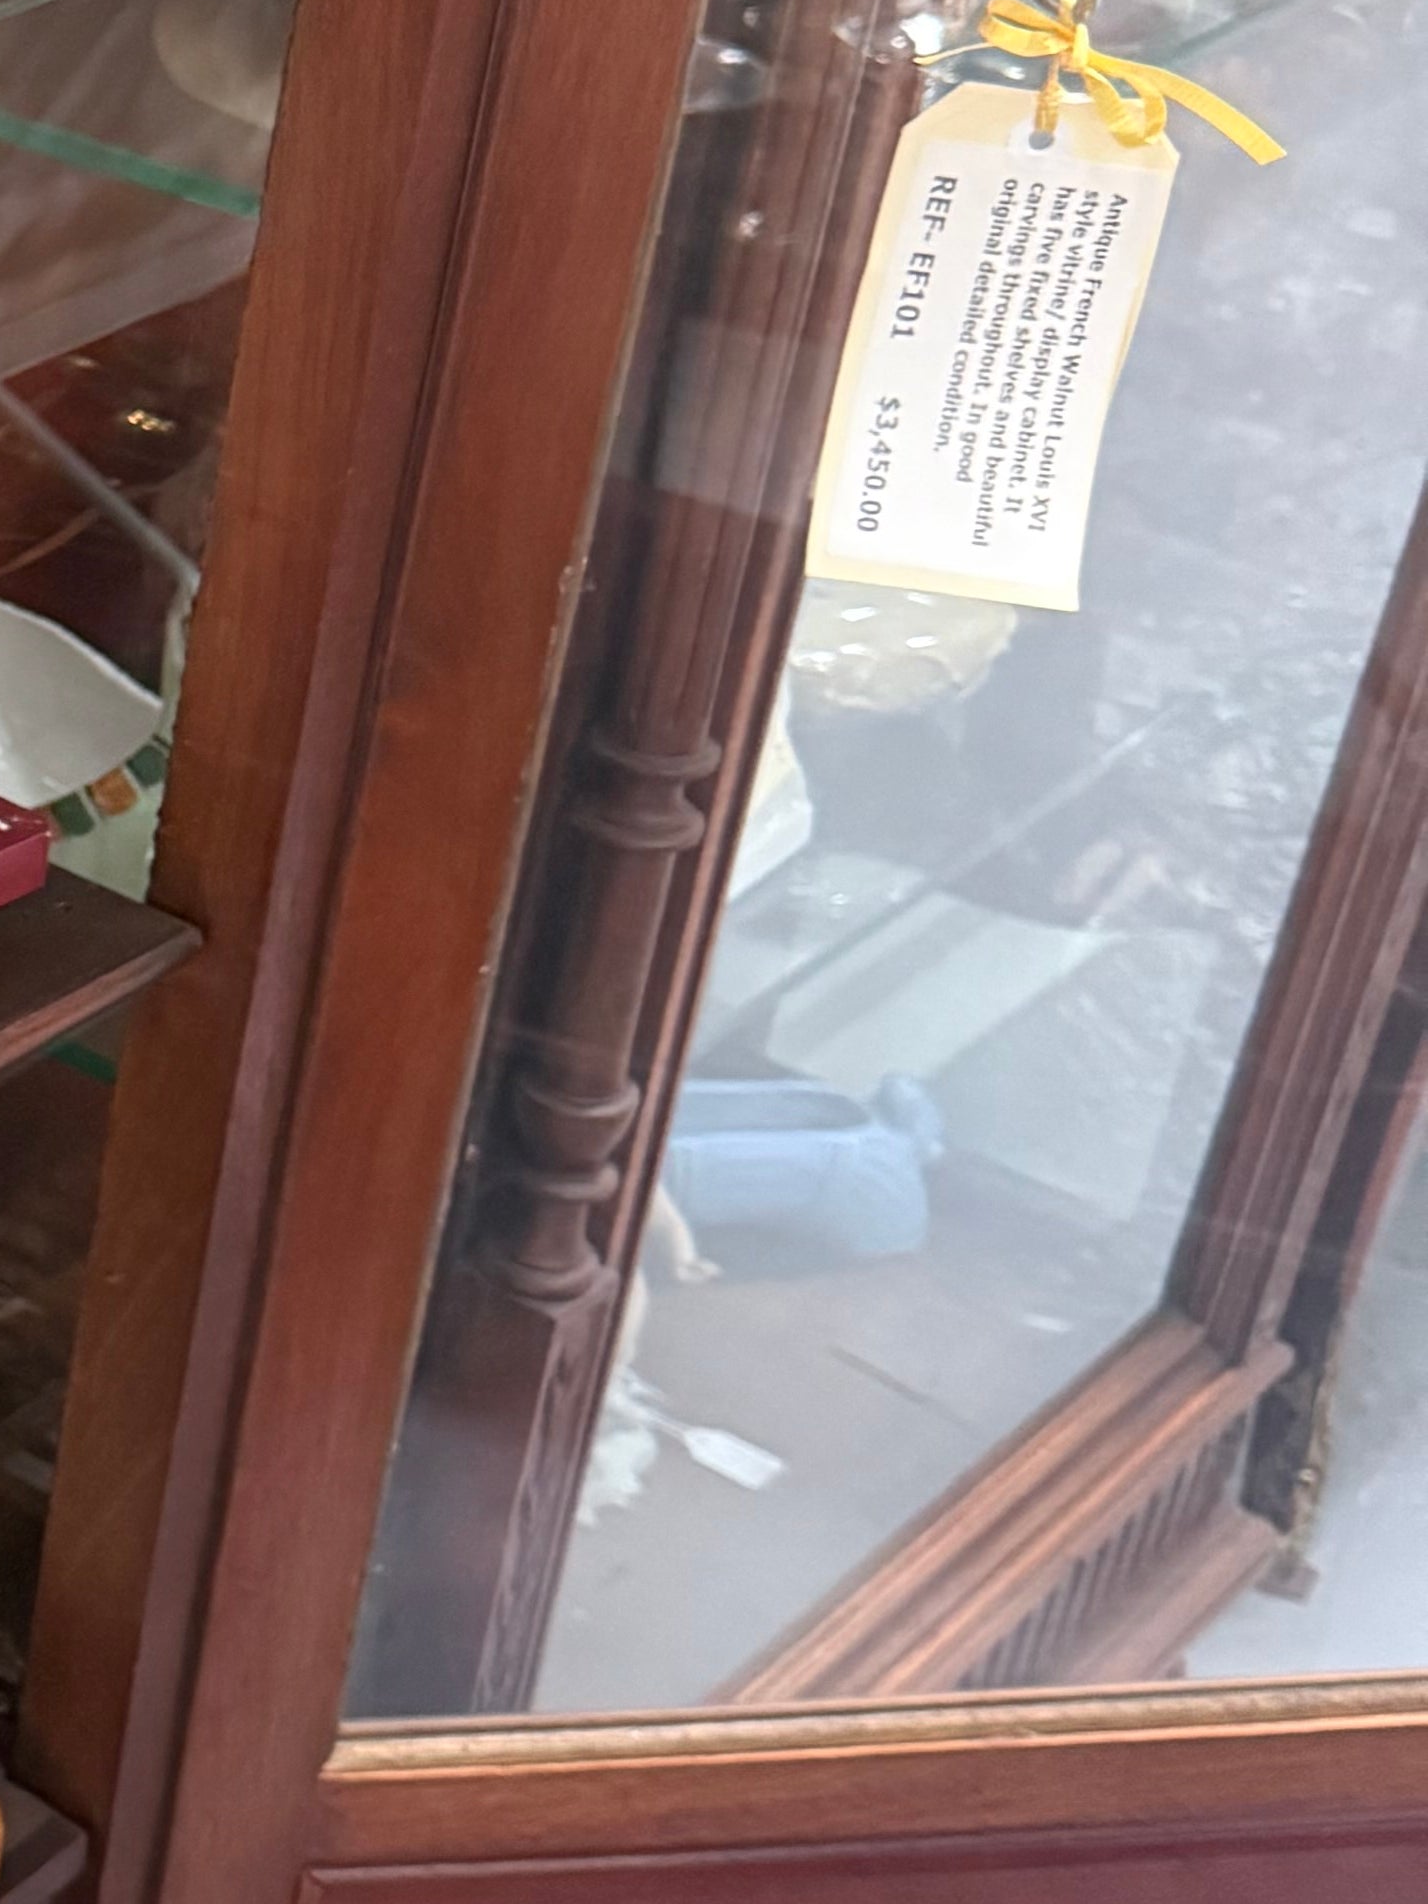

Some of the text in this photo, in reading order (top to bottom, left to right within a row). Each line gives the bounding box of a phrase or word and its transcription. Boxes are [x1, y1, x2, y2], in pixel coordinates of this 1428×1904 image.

[856, 175, 958, 532] REF- EF101 $3,450.00
[933, 178, 1018, 452] original detailed condition.
[955, 182, 1045, 483] carvings throughout. In good
[971, 186, 1077, 546] has five fixed shelves and beautiful
[1003, 190, 1099, 513] style vitrine/ display cabinet. It
[1027, 193, 1128, 531] Antique French Walnut Louis XVI
